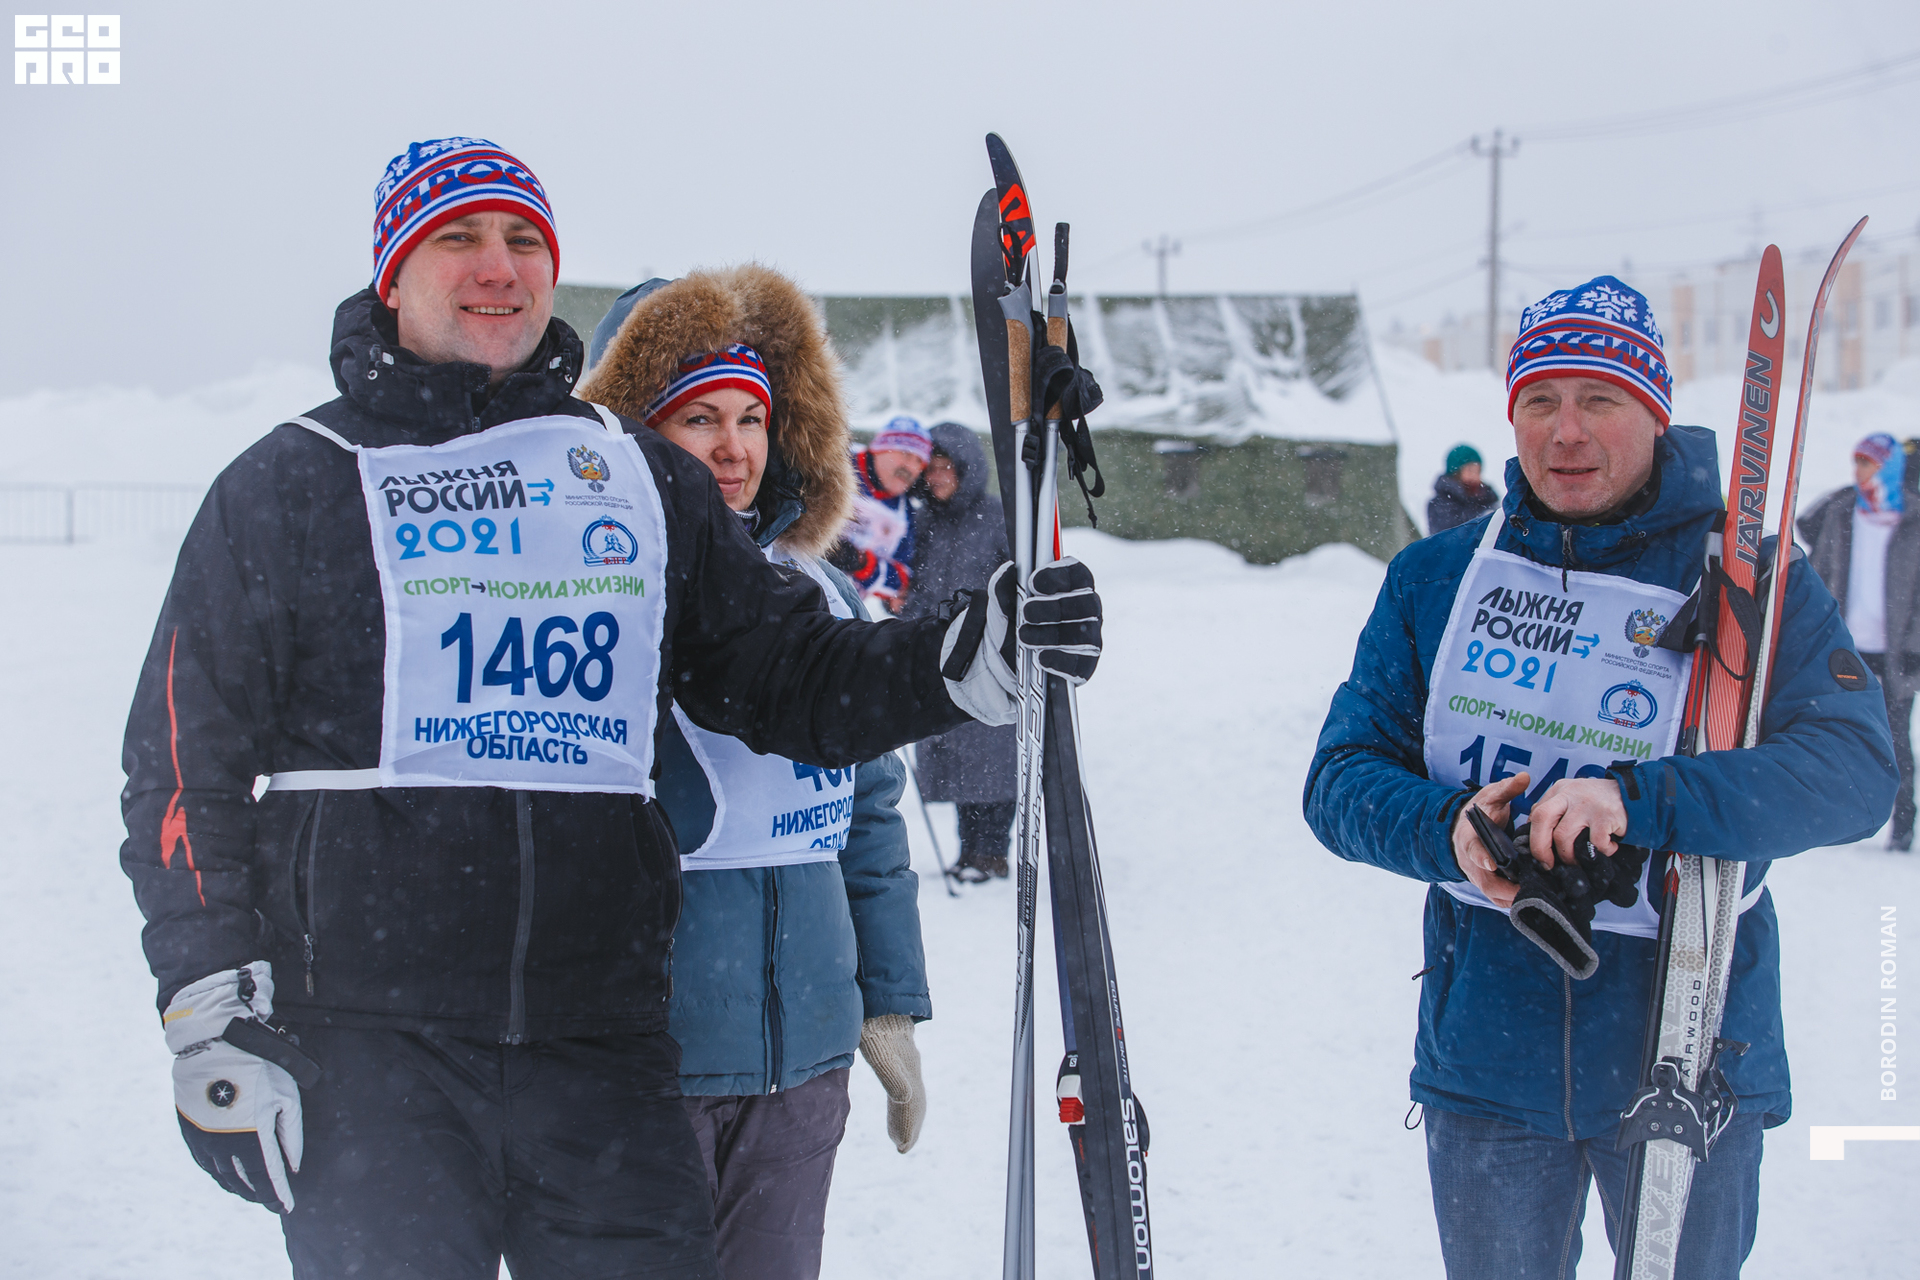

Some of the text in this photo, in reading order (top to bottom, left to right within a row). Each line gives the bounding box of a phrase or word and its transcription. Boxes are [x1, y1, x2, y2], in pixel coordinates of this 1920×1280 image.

[378, 460, 519, 490] ЛЫЖНЯ
[384, 479, 527, 517] РОССИИ
[564, 500, 601, 508] РОССИЙСКОЙ
[565, 494, 609, 502] МИНИСТЕРСТВО
[395, 516, 522, 561] 2021
[403, 575, 646, 600] СПОРТ НОРМА ЖИЗНИ
[1478, 586, 1585, 627] ЛЫЖНЯ
[1470, 608, 1574, 656] РОССИИ
[441, 611, 620, 703] 1468
[1460, 639, 1558, 694] 2021
[1600, 657, 1673, 681] РОССИЙСКОЙ ФЕДЕРАЦИИ
[1604, 652, 1670, 674] МИНИСТЕРСТВО СПОРТА
[415, 710, 628, 746] НИЖЕГОРОДСКАЯ
[1448, 694, 1653, 761] СПОРТ НОРМА ЖИЗНИ
[466, 734, 588, 765] ОБЛАСТЬ
[771, 795, 853, 838] НИЖЕГОРОД
[1682, 979, 1702, 1078] AIRWOOD
